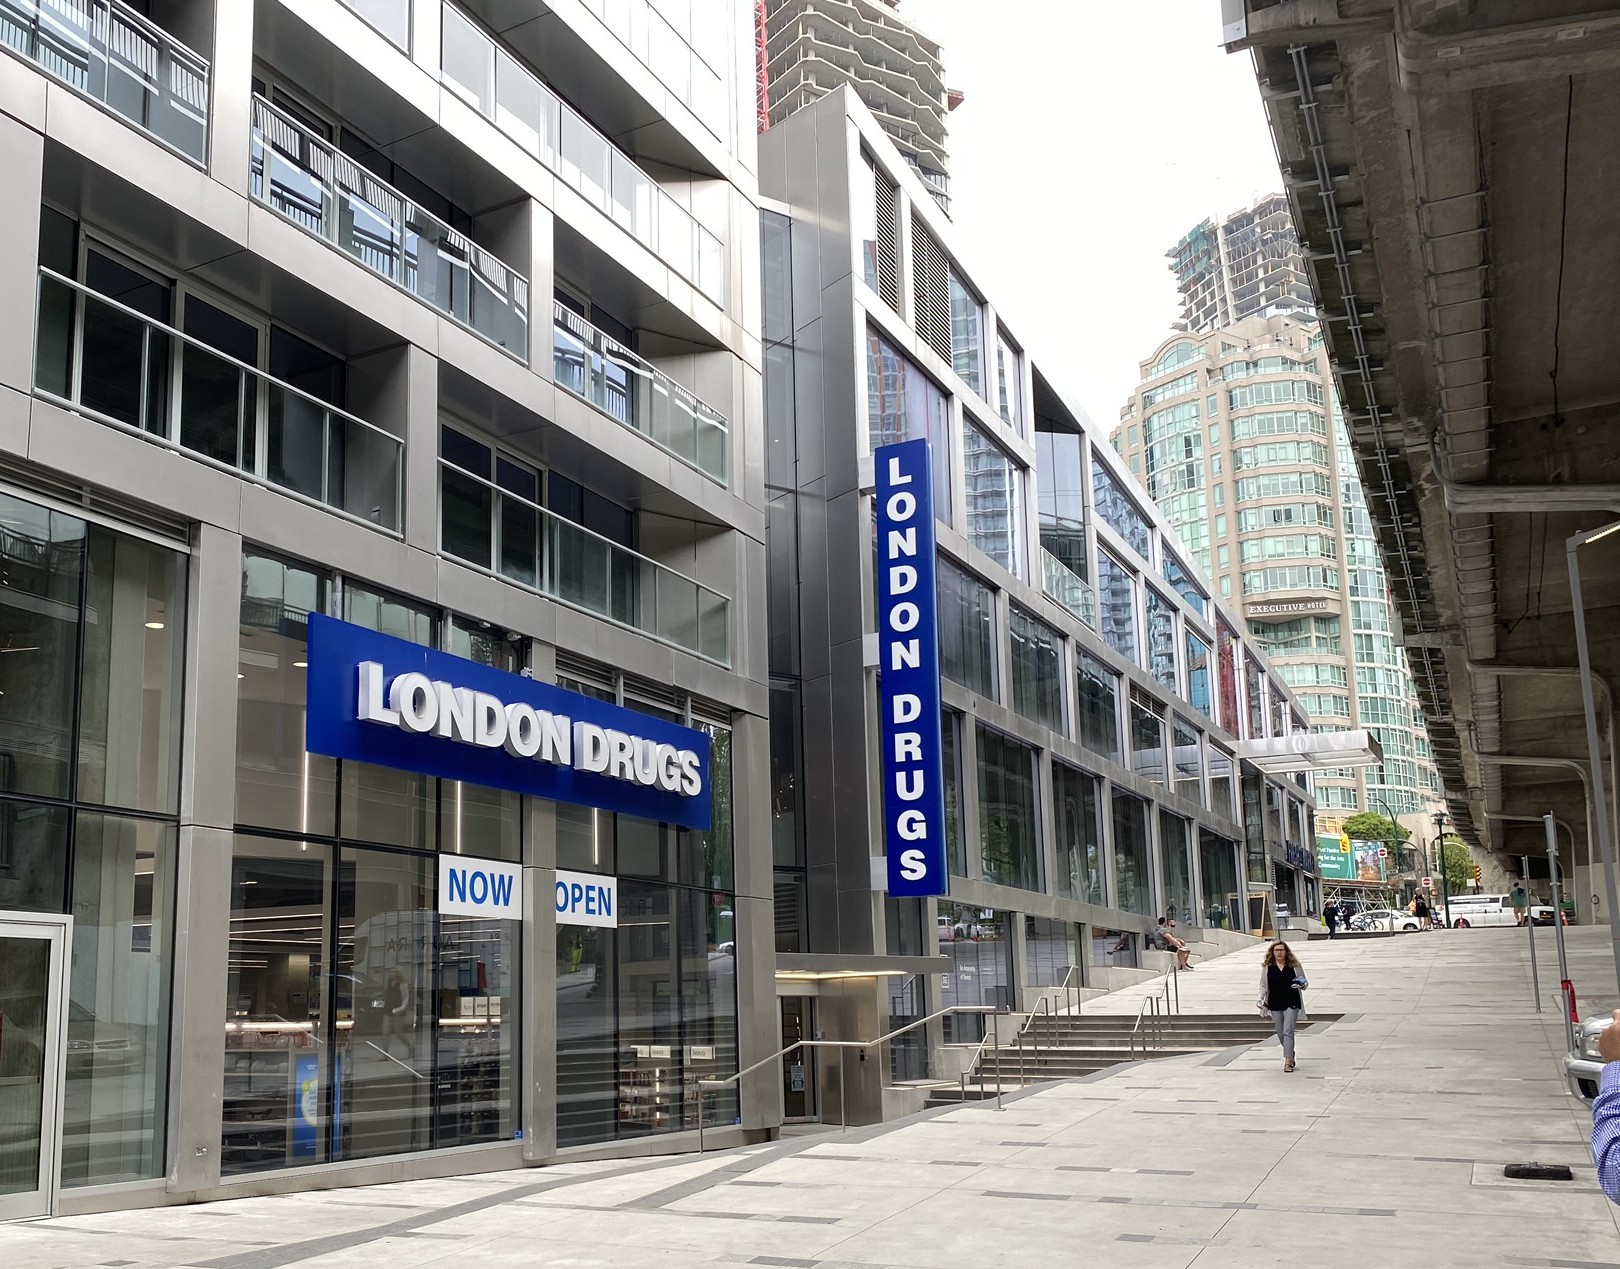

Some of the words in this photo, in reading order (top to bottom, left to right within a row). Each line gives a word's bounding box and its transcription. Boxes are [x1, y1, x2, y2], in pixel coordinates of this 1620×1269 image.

[886, 457, 920, 671] LONDON
[1250, 603, 1306, 614] EXECUTIVE
[358, 660, 572, 766] LONDON
[573, 721, 702, 797] DRUGS
[893, 693, 927, 882] DRUGS
[447, 868, 514, 907] NOW
[555, 881, 613, 917] OPEN
